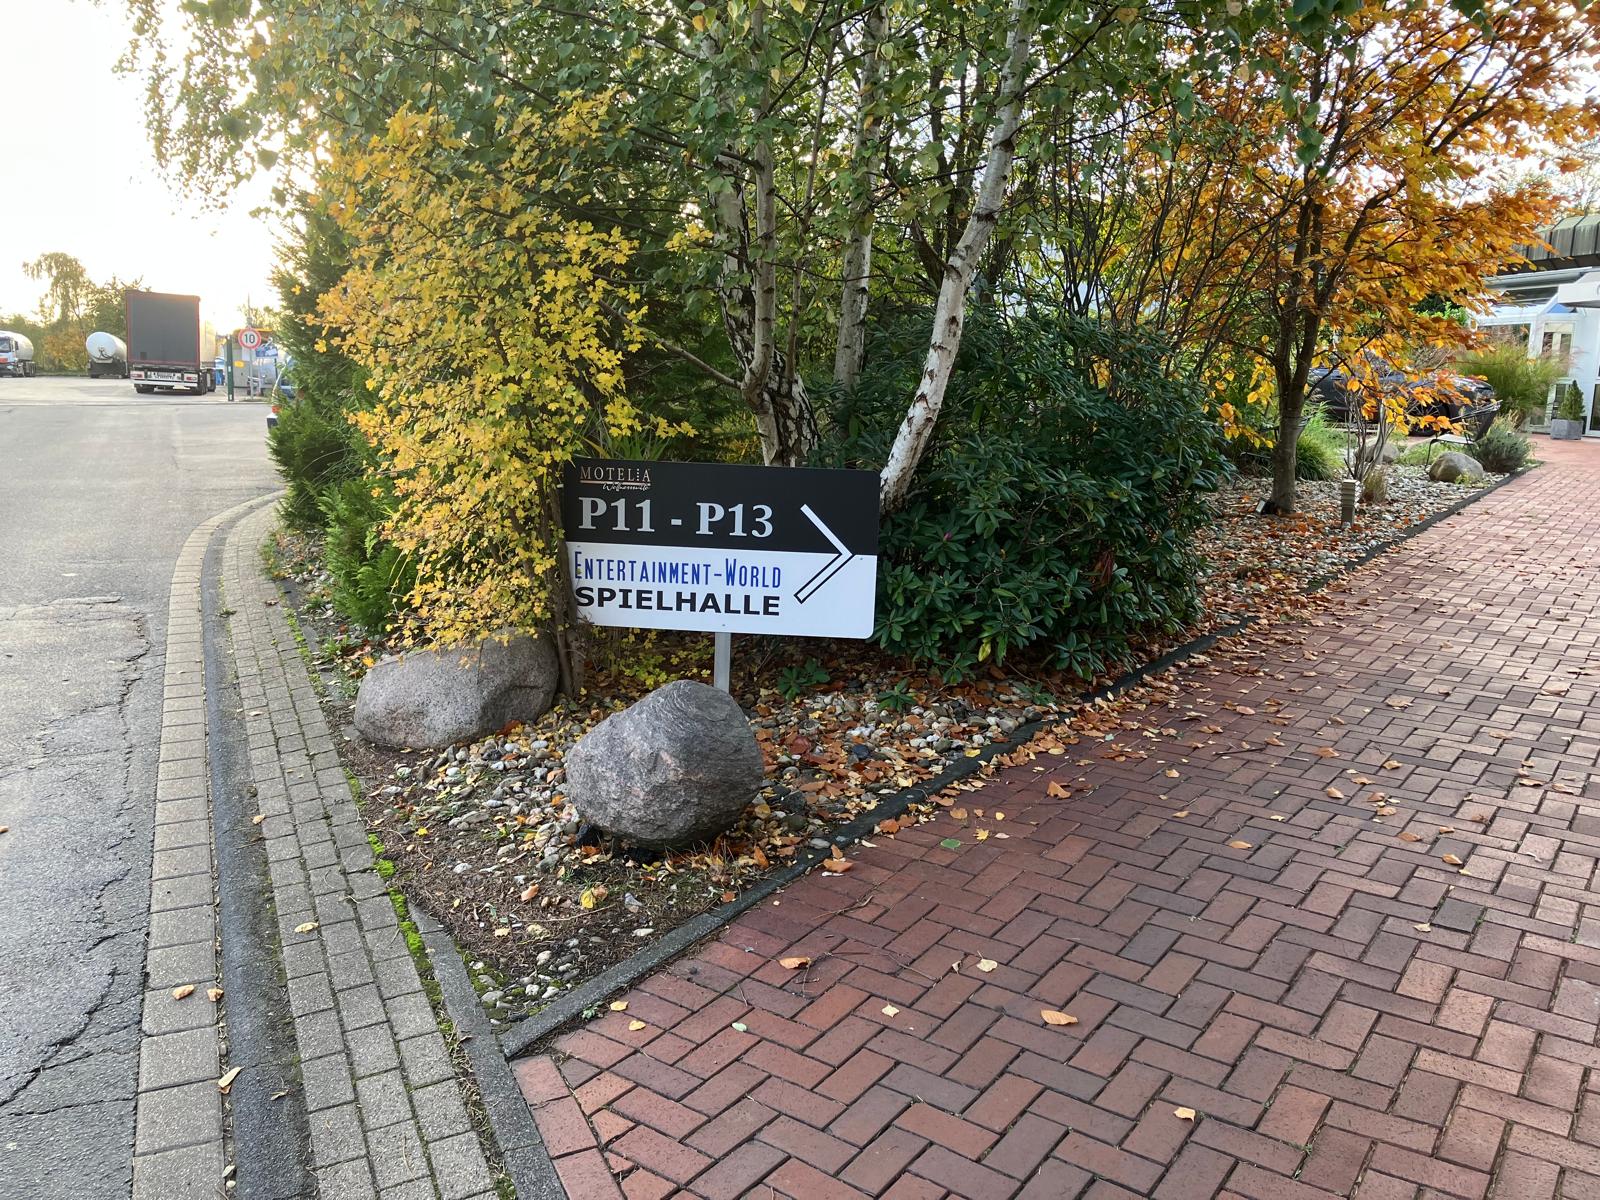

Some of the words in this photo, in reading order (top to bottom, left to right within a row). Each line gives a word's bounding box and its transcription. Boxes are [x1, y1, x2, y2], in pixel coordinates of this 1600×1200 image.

[245, 334, 255, 343] 10
[580, 466, 650, 482] MOTELIA
[578, 497, 655, 532] P11
[671, 518, 682, 526] -
[695, 502, 773, 538] P13
[575, 586, 780, 616] SPIELHALLE
